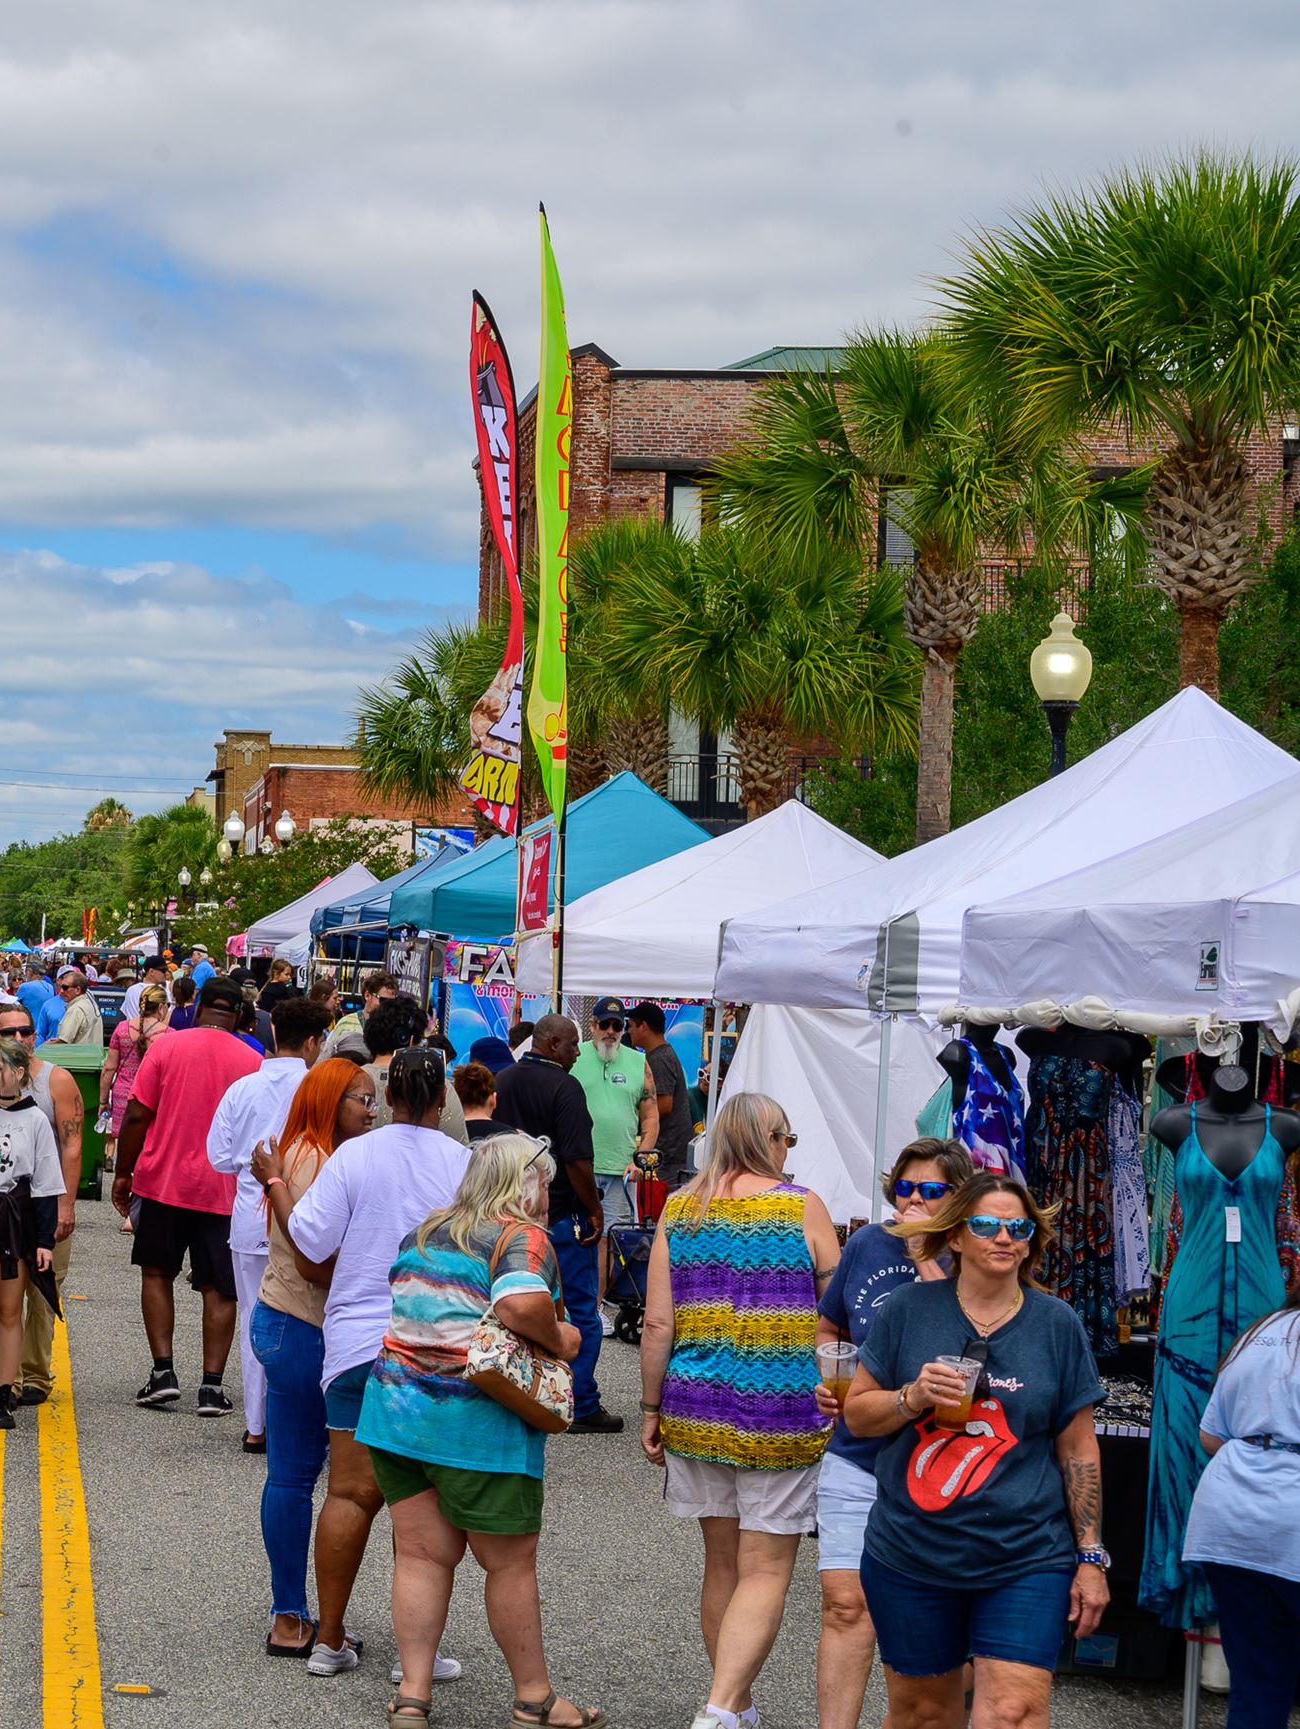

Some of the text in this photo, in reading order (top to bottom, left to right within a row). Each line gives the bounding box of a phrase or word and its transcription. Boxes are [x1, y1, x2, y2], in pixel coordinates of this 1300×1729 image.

[855, 1265, 915, 1309] THE FLORIDA
[987, 1372, 1024, 1392] tones
